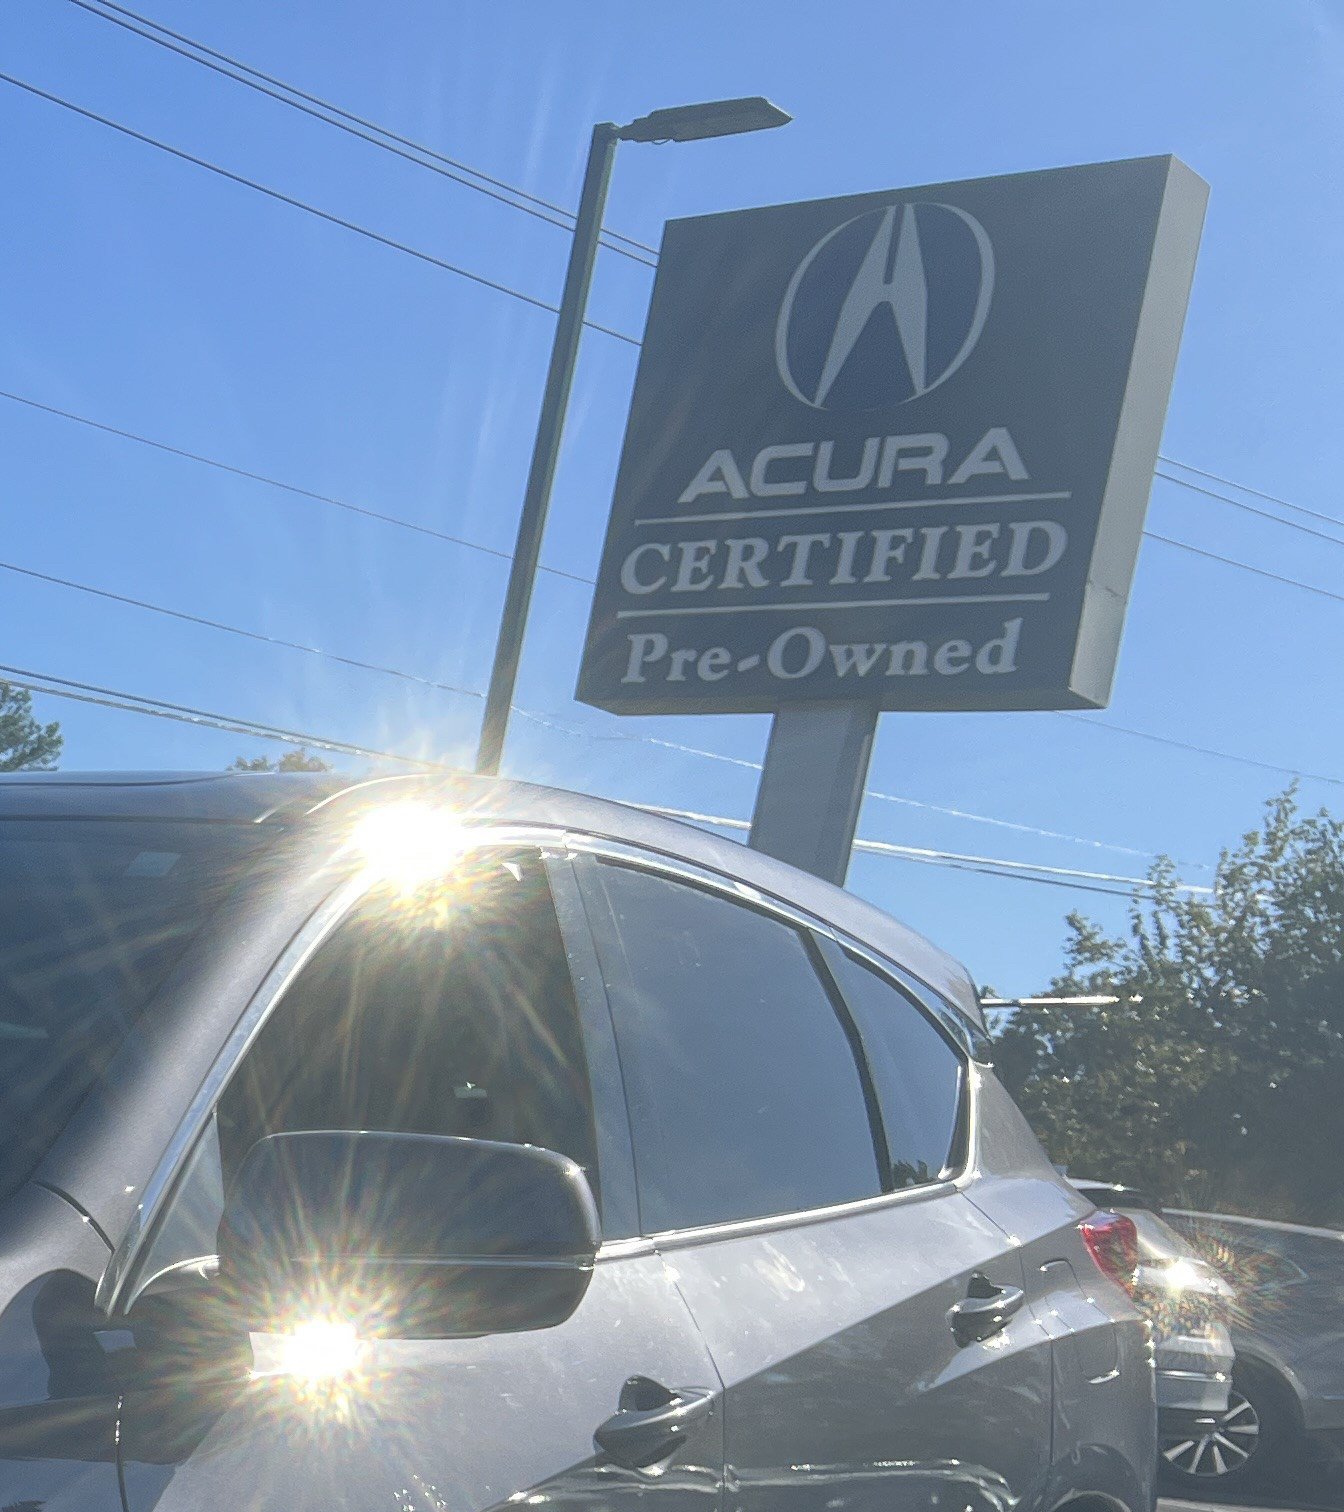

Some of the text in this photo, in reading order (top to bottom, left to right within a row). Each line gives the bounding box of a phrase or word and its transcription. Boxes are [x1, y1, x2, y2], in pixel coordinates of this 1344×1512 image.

[678, 427, 1029, 503] ACURA
[620, 520, 1069, 594] CERTIFIED
[620, 617, 1024, 684] Pre-Owned
